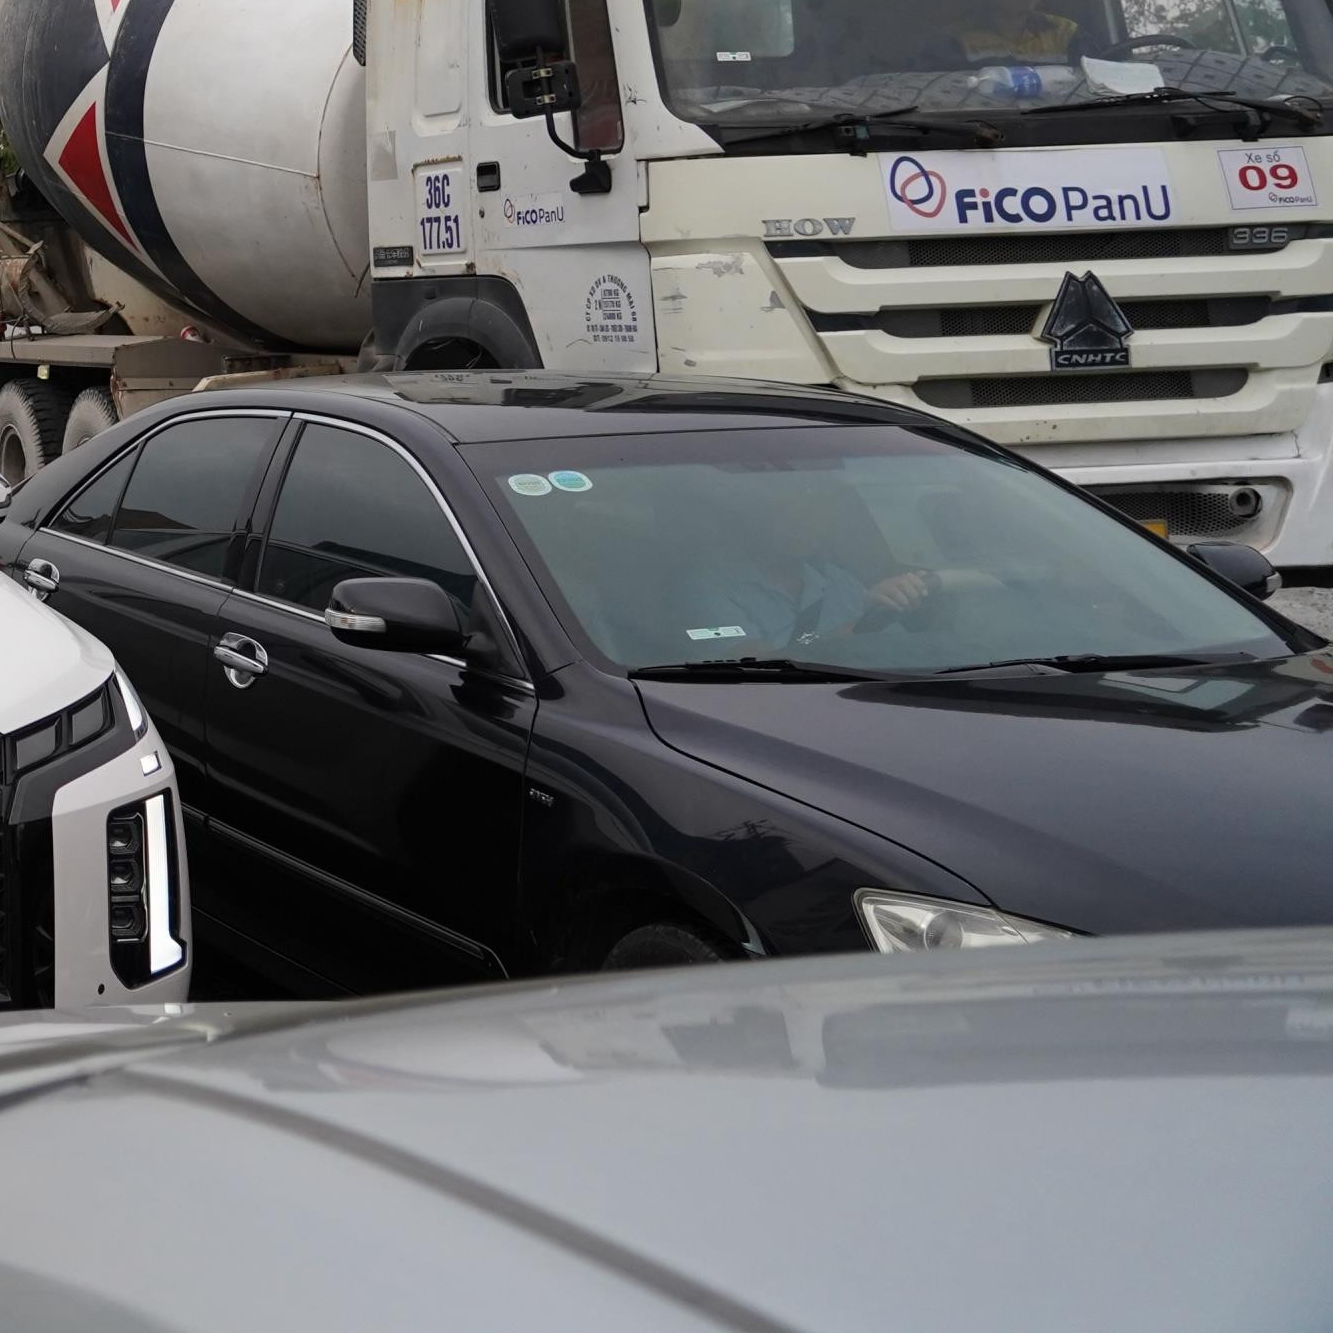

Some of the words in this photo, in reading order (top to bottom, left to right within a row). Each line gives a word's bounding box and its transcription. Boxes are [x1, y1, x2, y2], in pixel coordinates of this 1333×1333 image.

[1245, 152, 1262, 164] Xe
[1266, 149, 1281, 163] số
[1238, 163, 1299, 191] 09
[425, 173, 451, 210] 36C
[420, 214, 462, 250] 177.51
[761, 217, 856, 237] HOW
[1233, 227, 1289, 244] 336
[1057, 352, 1127, 365] CNHTC
